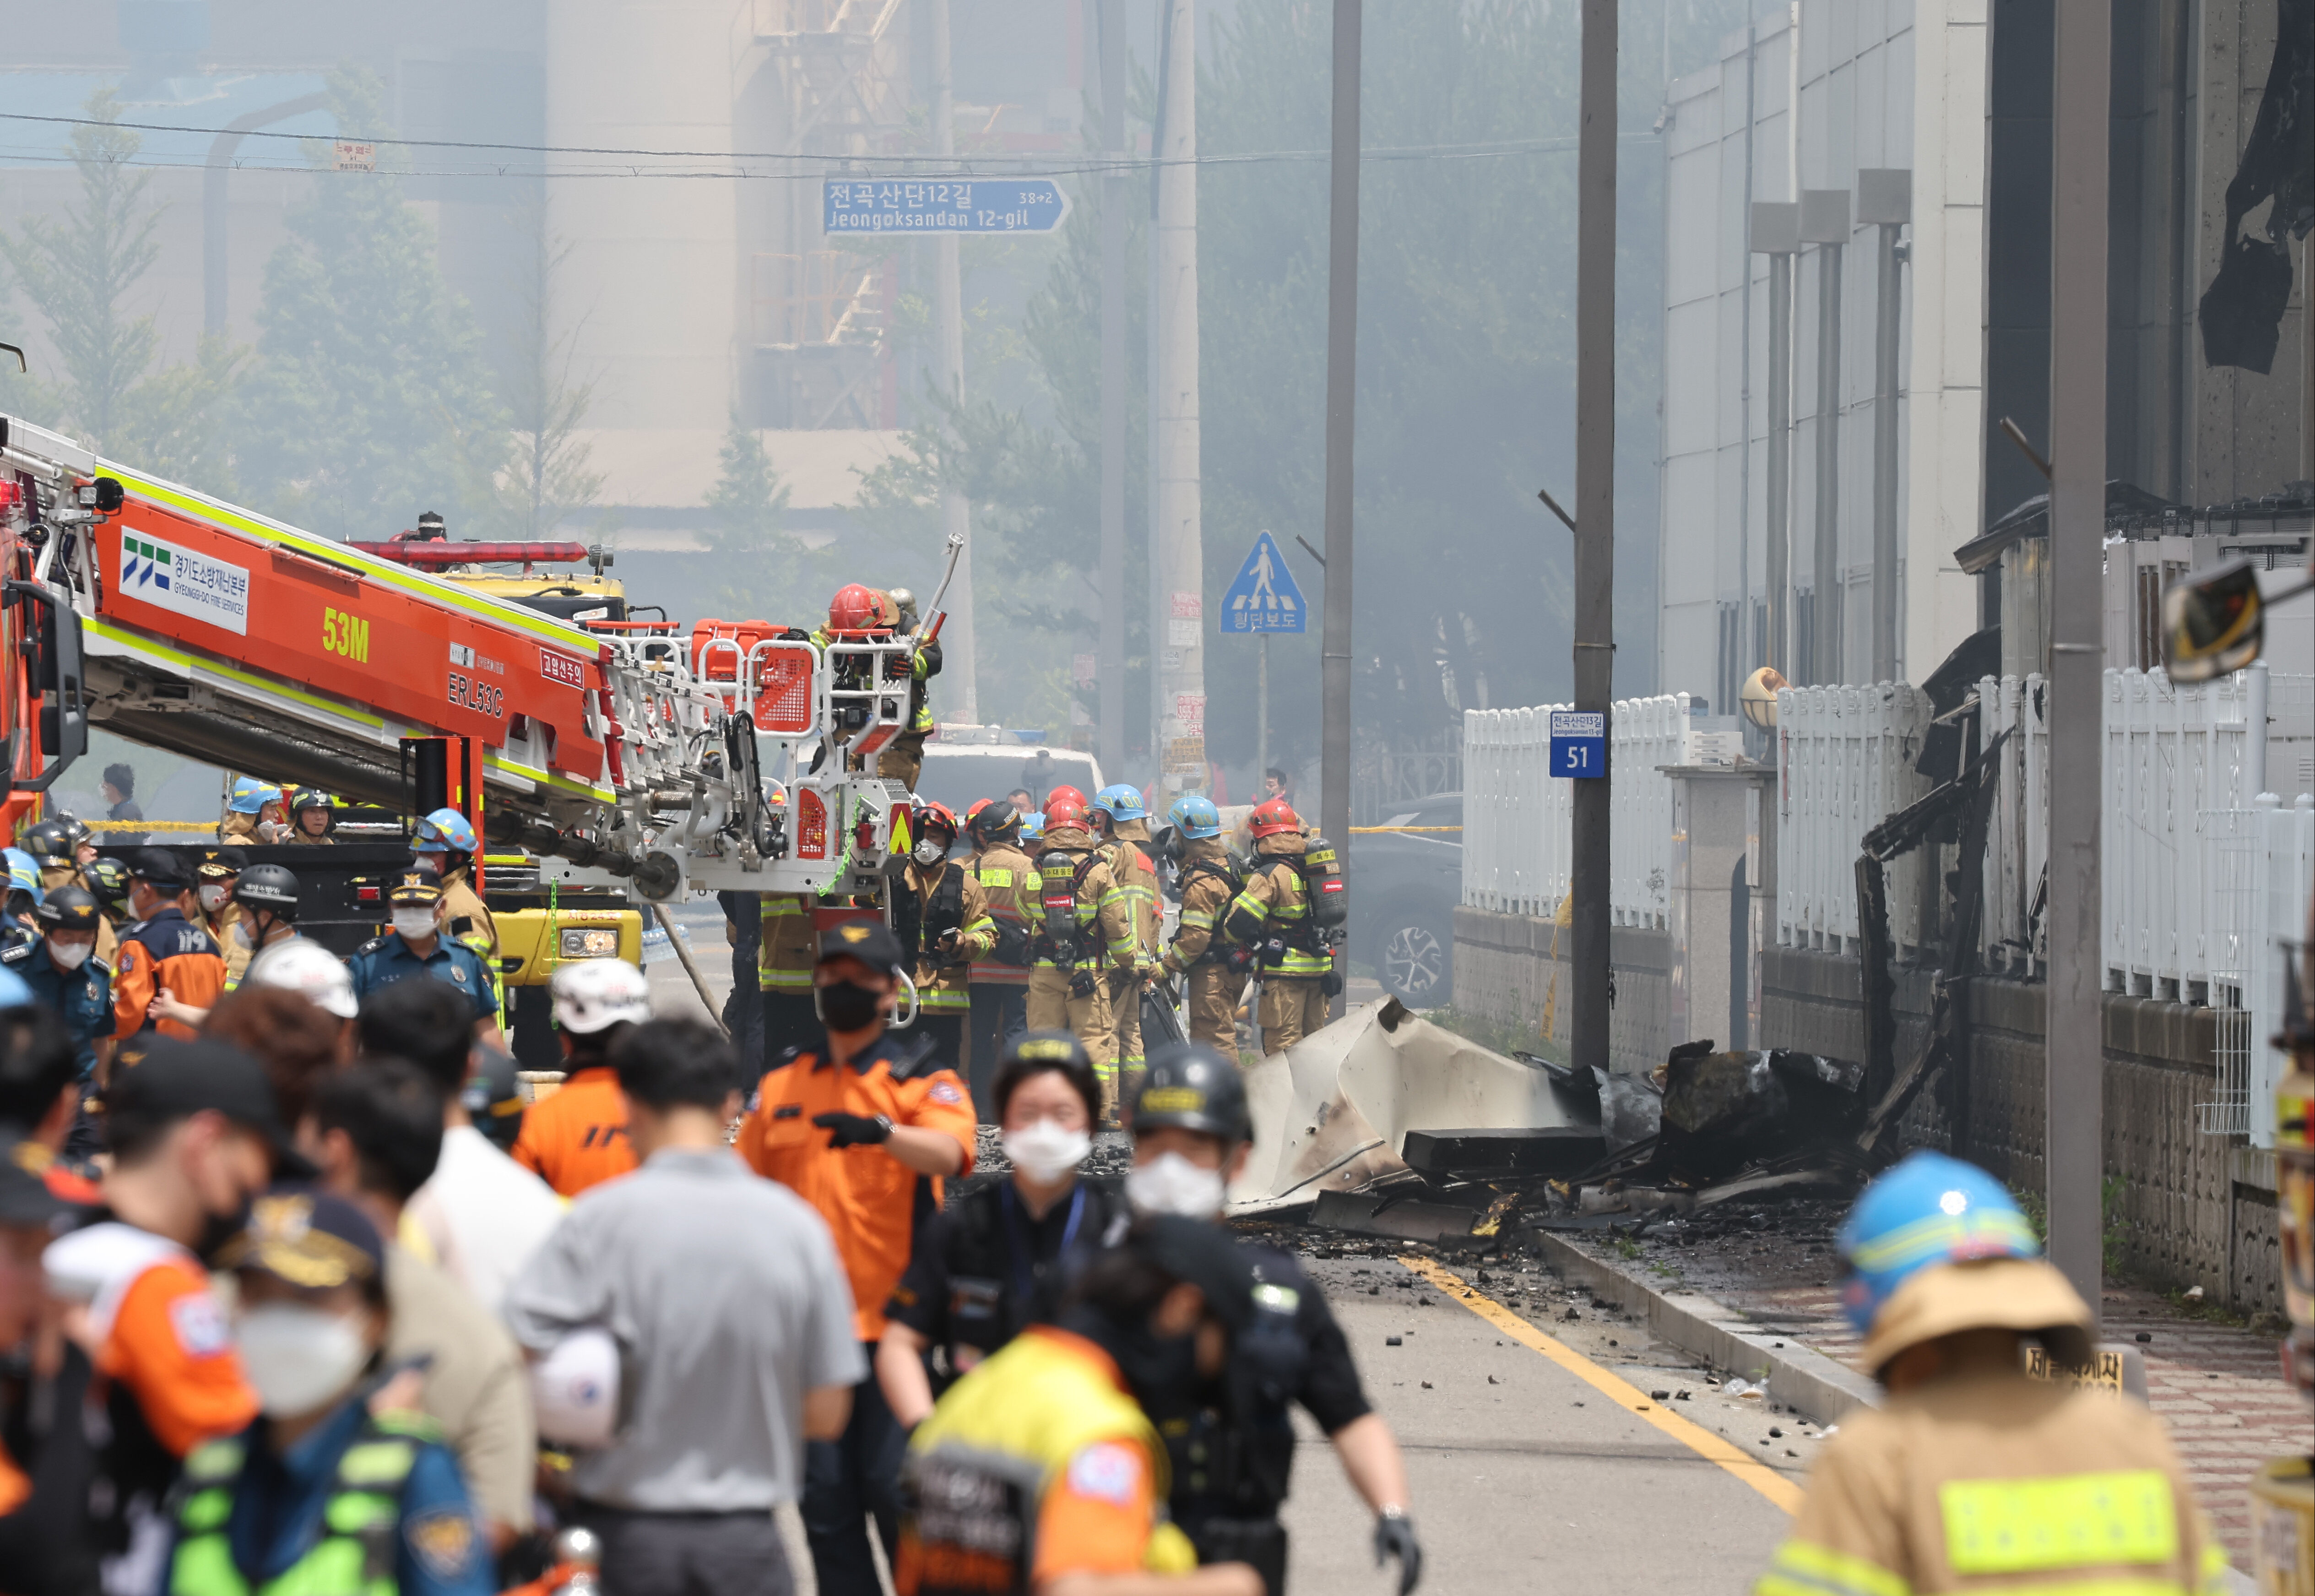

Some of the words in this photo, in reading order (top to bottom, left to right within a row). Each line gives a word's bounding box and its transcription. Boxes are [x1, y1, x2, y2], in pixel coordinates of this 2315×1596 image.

[829, 184, 972, 209] 전곡산단12길
[829, 210, 969, 230] Jeongoksandan
[977, 210, 1029, 229] 12-gil
[175, 554, 246, 598] 경기도소방재난본부
[174, 582, 210, 603] GYEONGGI-DO
[1233, 612, 1296, 629] 횡단보도
[322, 607, 369, 663] 53M
[543, 654, 581, 684] 고압선주의
[448, 671, 504, 718] ERL53C
[1553, 716, 1602, 727] 전곡산단13길
[1567, 746, 1588, 768] 51
[177, 930, 207, 951] 119
